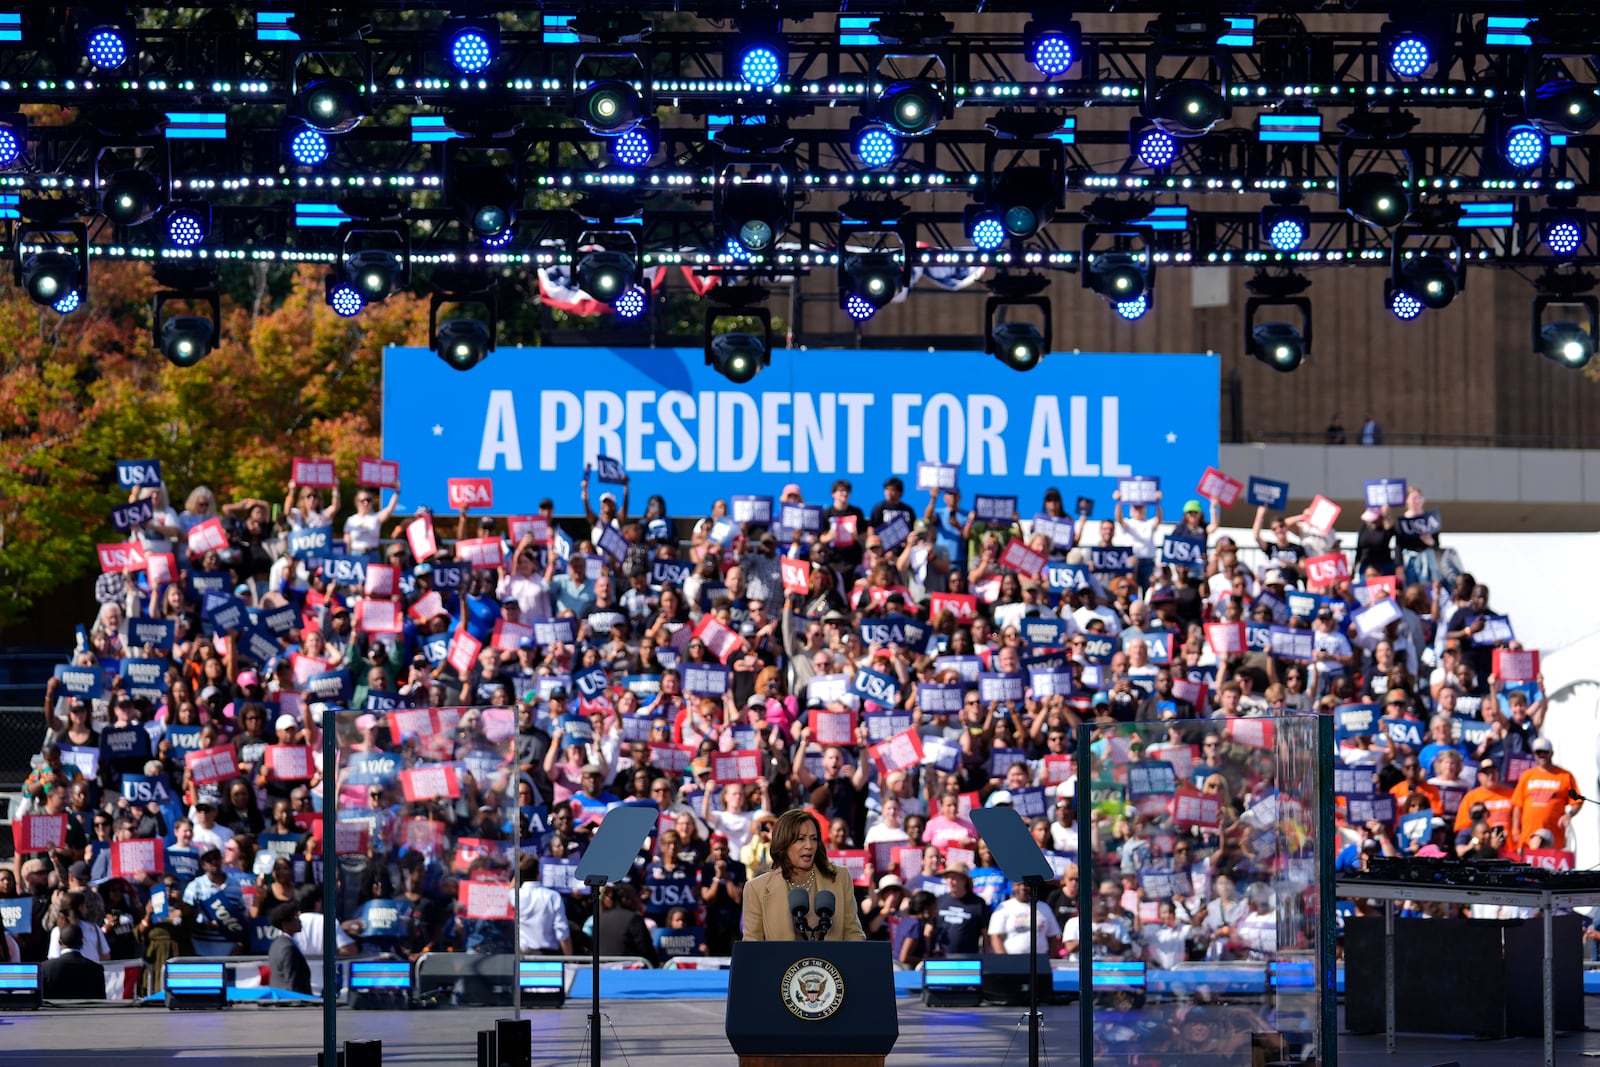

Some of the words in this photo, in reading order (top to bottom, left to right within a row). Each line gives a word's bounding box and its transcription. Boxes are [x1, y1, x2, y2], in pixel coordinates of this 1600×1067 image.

[479, 391, 522, 470] A
[540, 391, 874, 473] PRESIDENT
[893, 393, 1008, 475] FOR
[1025, 396, 1132, 477] ALL
[118, 465, 159, 485] USA
[451, 485, 490, 503] USA
[113, 503, 152, 528] USA
[1402, 515, 1440, 535] USA
[292, 533, 326, 550] vote
[1164, 539, 1201, 562] USA
[100, 548, 144, 568] USA
[1093, 551, 1131, 569] USA
[325, 559, 365, 581] USA
[653, 563, 691, 586] USA
[1049, 568, 1089, 588] USA
[1309, 559, 1348, 581] USA
[933, 600, 972, 620] USA
[861, 624, 904, 645] USA
[1245, 627, 1270, 648] US
[424, 640, 448, 662] US
[1086, 640, 1112, 656] ote
[63, 672, 95, 686] HARRIS
[128, 664, 161, 677] HARRIS
[132, 675, 155, 683] WALZ
[1187, 670, 1216, 690] SA
[67, 684, 89, 692] WALZ
[311, 677, 342, 691] HARRIS
[576, 669, 608, 694] US
[855, 671, 896, 708] USA
[107, 731, 137, 744] HARRIS
[359, 757, 394, 773] vote
[123, 780, 169, 801] USA
[1526, 855, 1571, 870] USA
[651, 885, 695, 905] USA
[368, 908, 398, 922] HARRIS
[661, 936, 695, 948] HARRIS
[783, 964, 800, 1001] PRESIDENT
[825, 963, 842, 990] UNITED
[789, 1001, 803, 1016] VICE
[823, 993, 842, 1016] STATES
